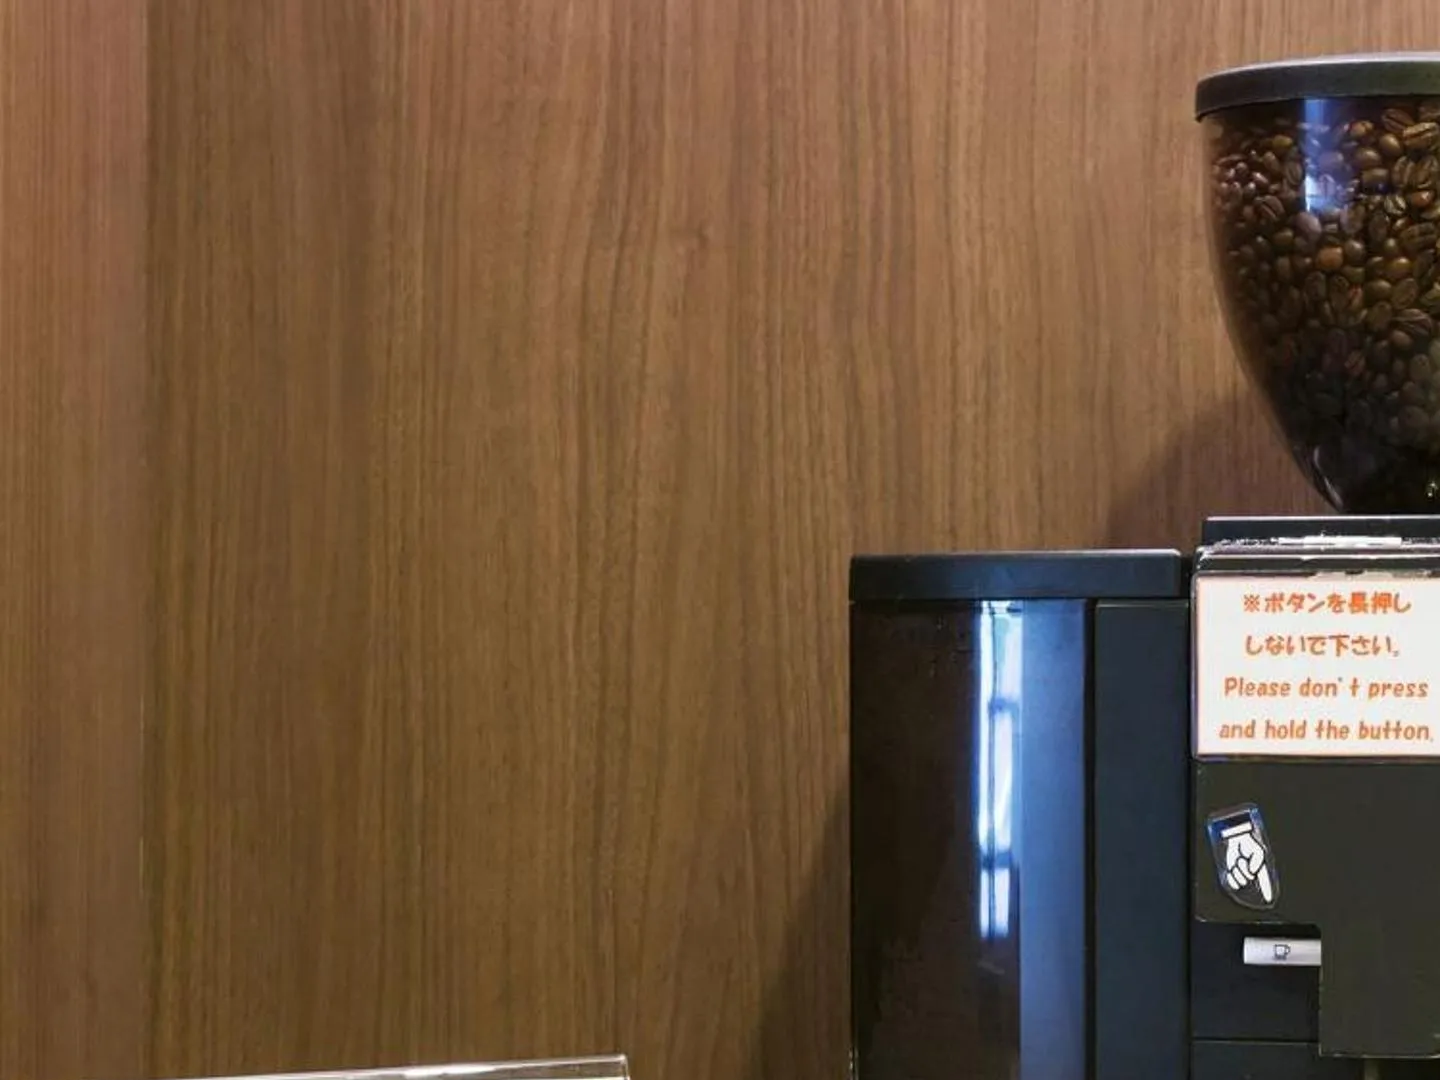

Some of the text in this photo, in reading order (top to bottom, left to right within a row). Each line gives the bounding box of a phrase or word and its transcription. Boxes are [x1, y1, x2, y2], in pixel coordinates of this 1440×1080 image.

[1243, 592, 1412, 614] ※ボタンを長押し
[1246, 635, 1399, 657] しないで下さい。
[1224, 677, 1291, 698] Please
[1368, 681, 1429, 699] press
[1219, 719, 1434, 742] and hold the button.
